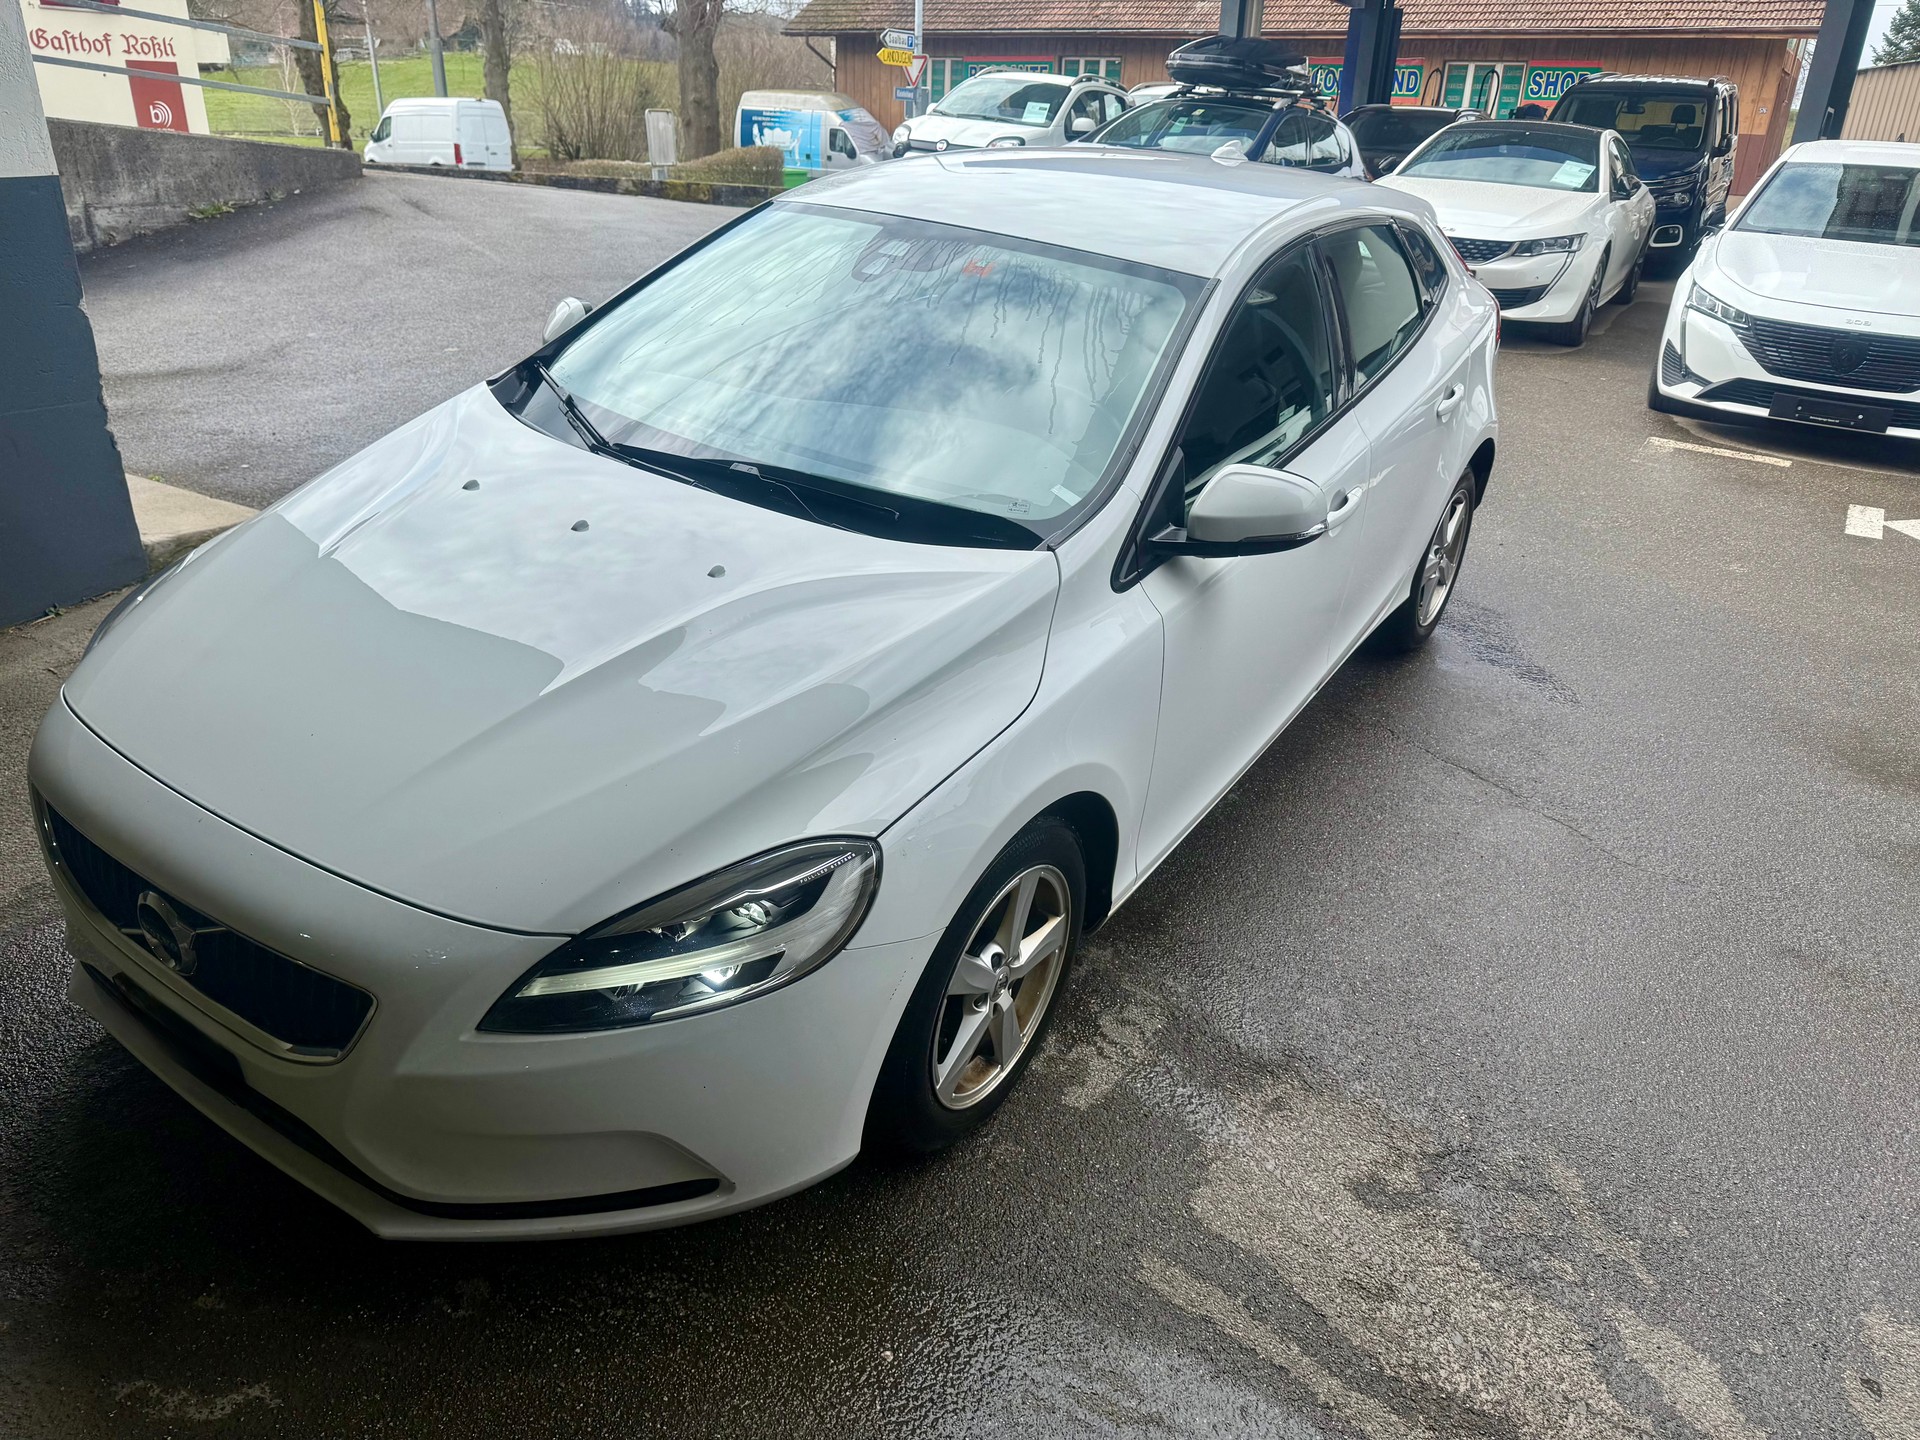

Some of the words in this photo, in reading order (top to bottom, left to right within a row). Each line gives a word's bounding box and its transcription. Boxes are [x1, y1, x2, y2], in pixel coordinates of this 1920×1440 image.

[29, 27, 112, 57] Gasthof
[1391, 68, 1420, 94] ND
[1528, 70, 1591, 98] SHO
